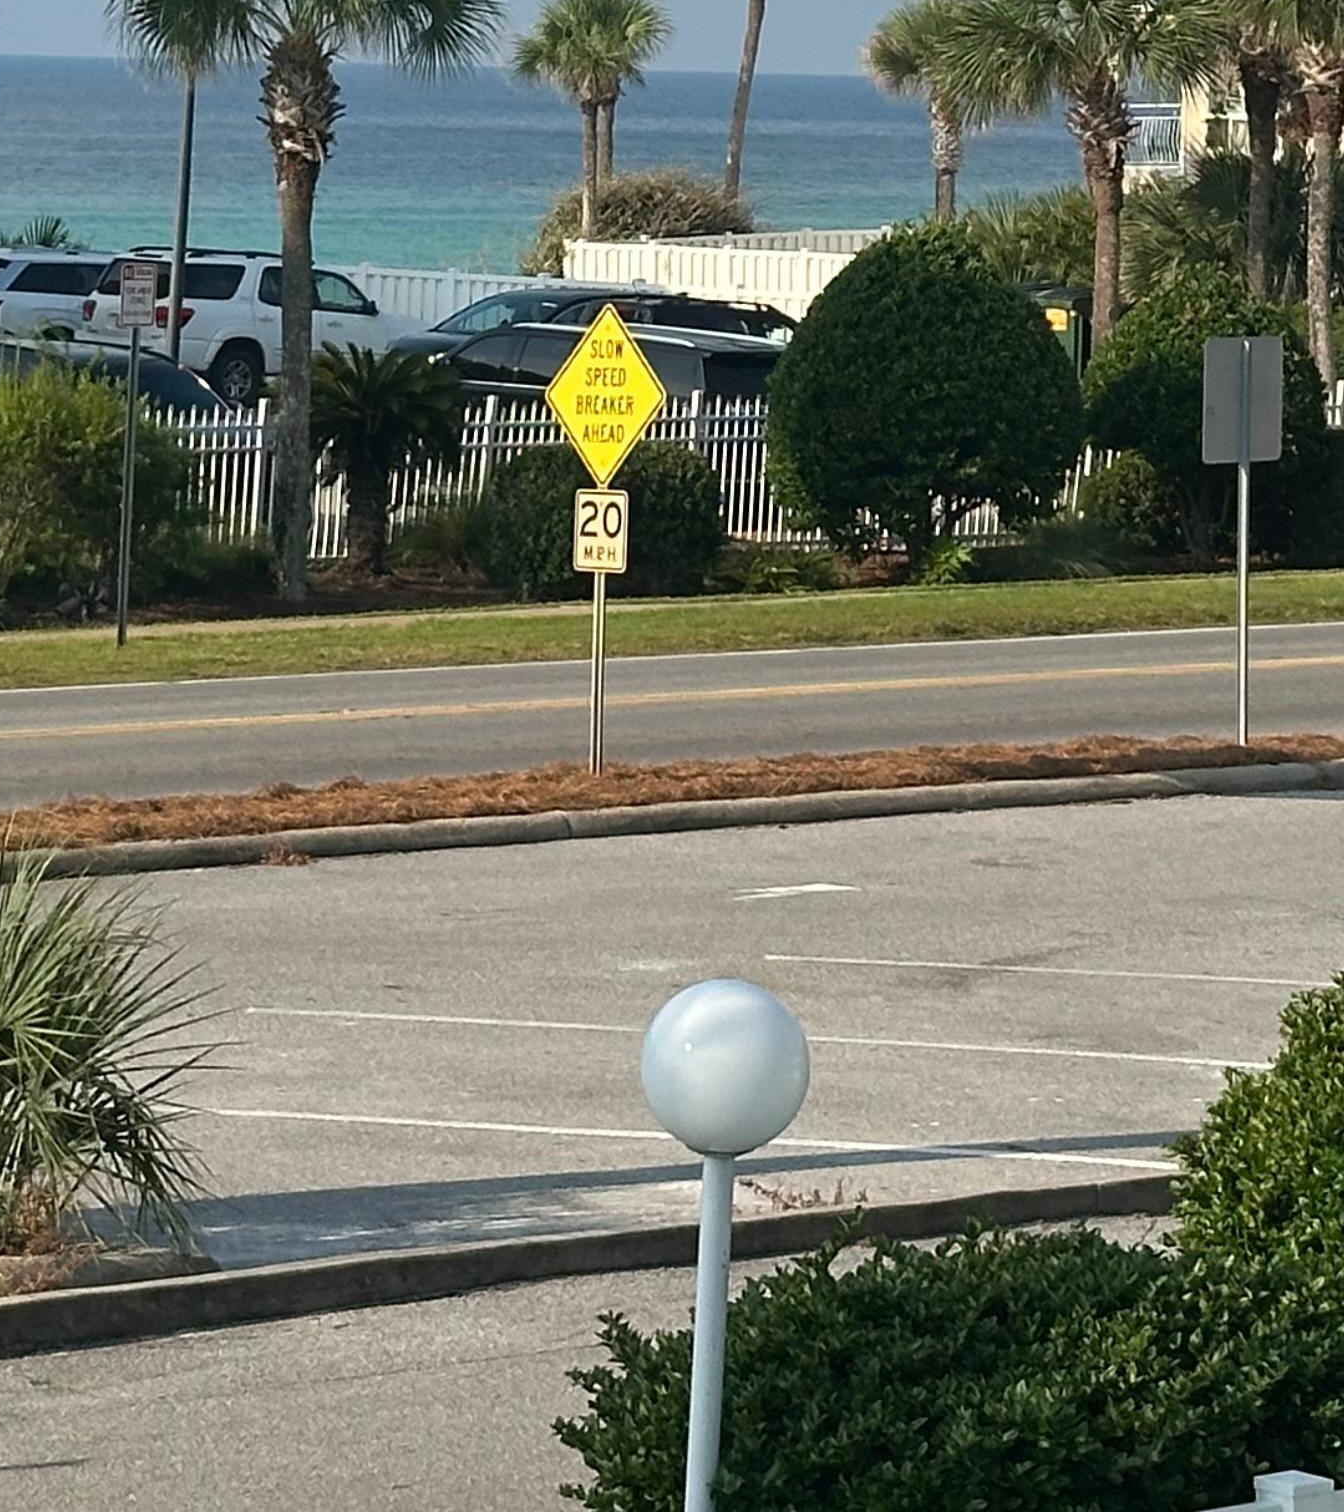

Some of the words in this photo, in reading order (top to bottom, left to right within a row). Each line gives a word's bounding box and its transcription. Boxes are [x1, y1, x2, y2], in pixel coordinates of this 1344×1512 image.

[590, 340, 623, 358] SLOW
[585, 368, 626, 386] SPEED
[576, 396, 633, 415] BREAKER
[583, 425, 624, 443] AHEAD
[580, 501, 621, 538] 20
